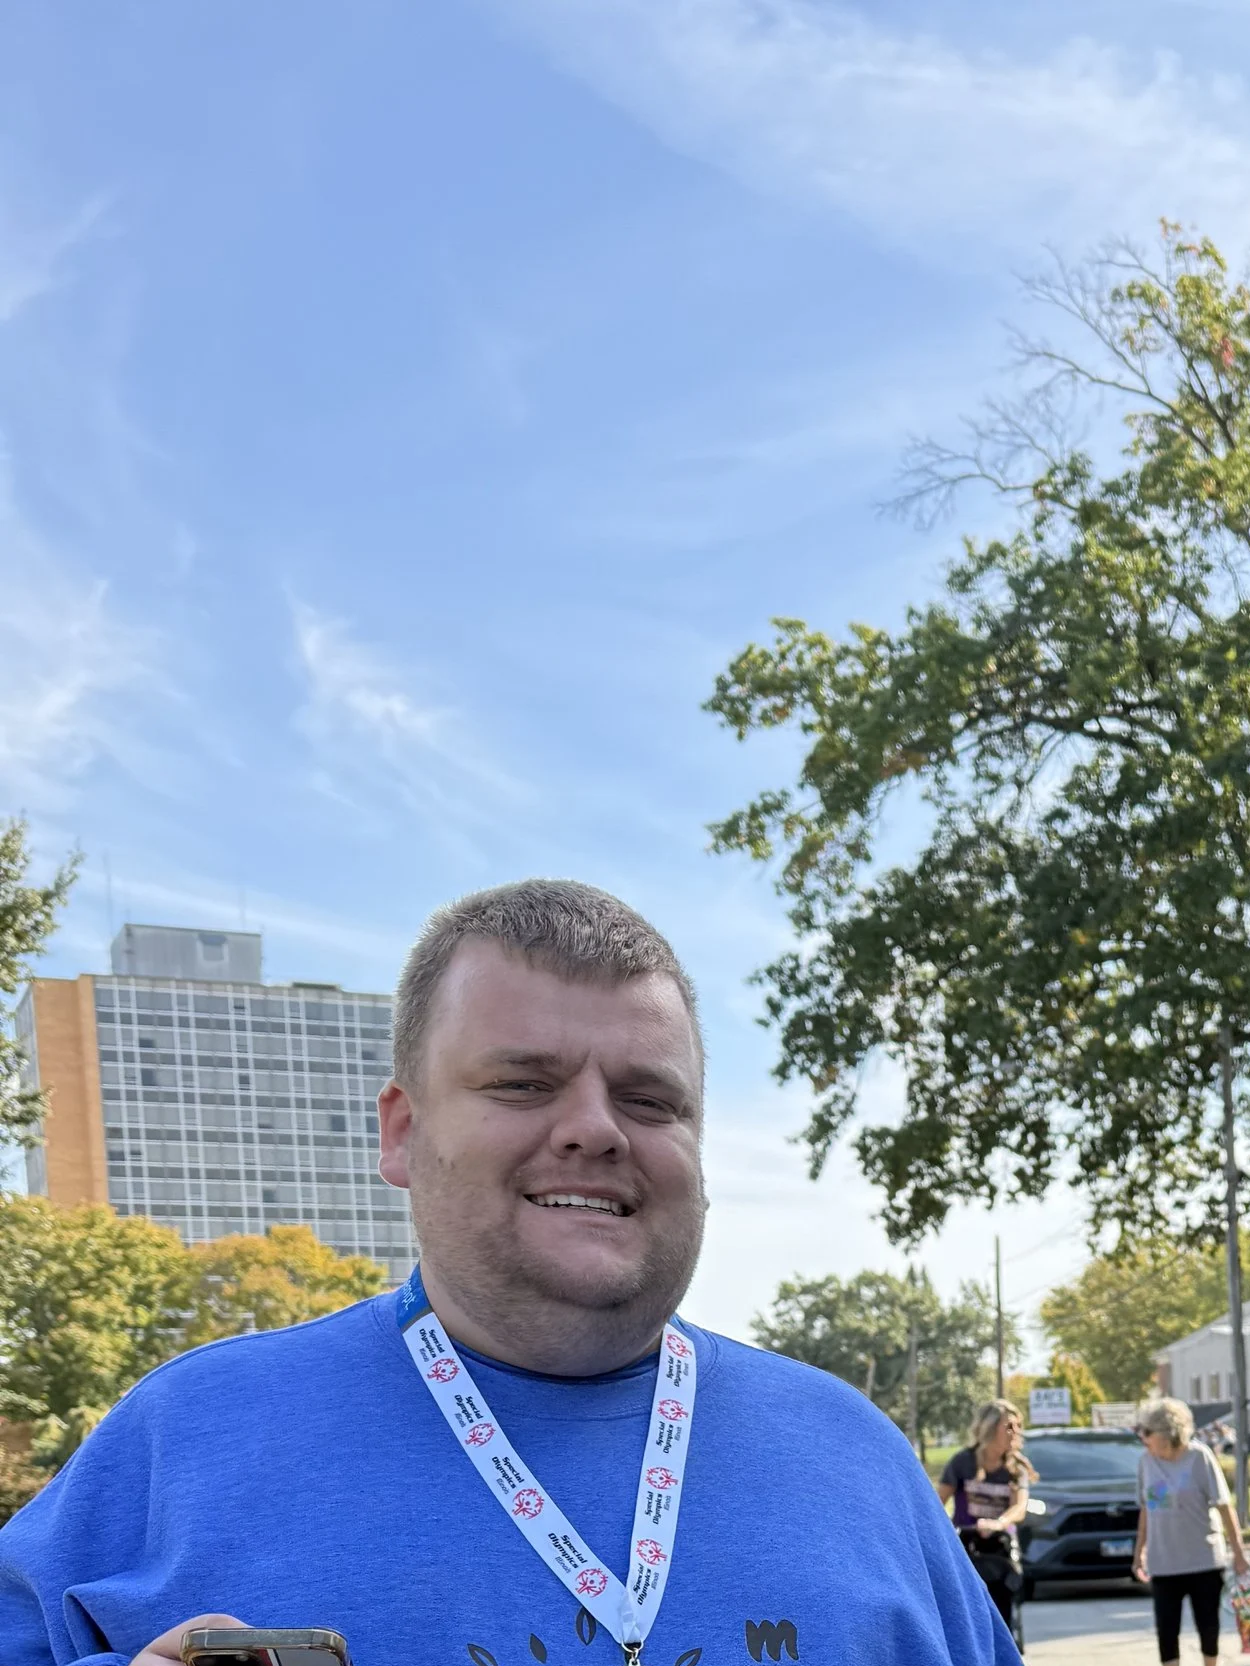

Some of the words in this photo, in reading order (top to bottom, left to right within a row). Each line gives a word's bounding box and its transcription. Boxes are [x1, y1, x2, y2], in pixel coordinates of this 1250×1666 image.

[465, 1396, 484, 1420] Special
[491, 1456, 517, 1489] Olympics
[502, 1456, 525, 1484] Special
[644, 1491, 654, 1516] Special
[652, 1493, 663, 1525] Olympics
[548, 1532, 579, 1569] Olympics
[561, 1534, 588, 1564] Special
[633, 1563, 644, 1594] Special
[637, 1569, 652, 1606] Olympics
